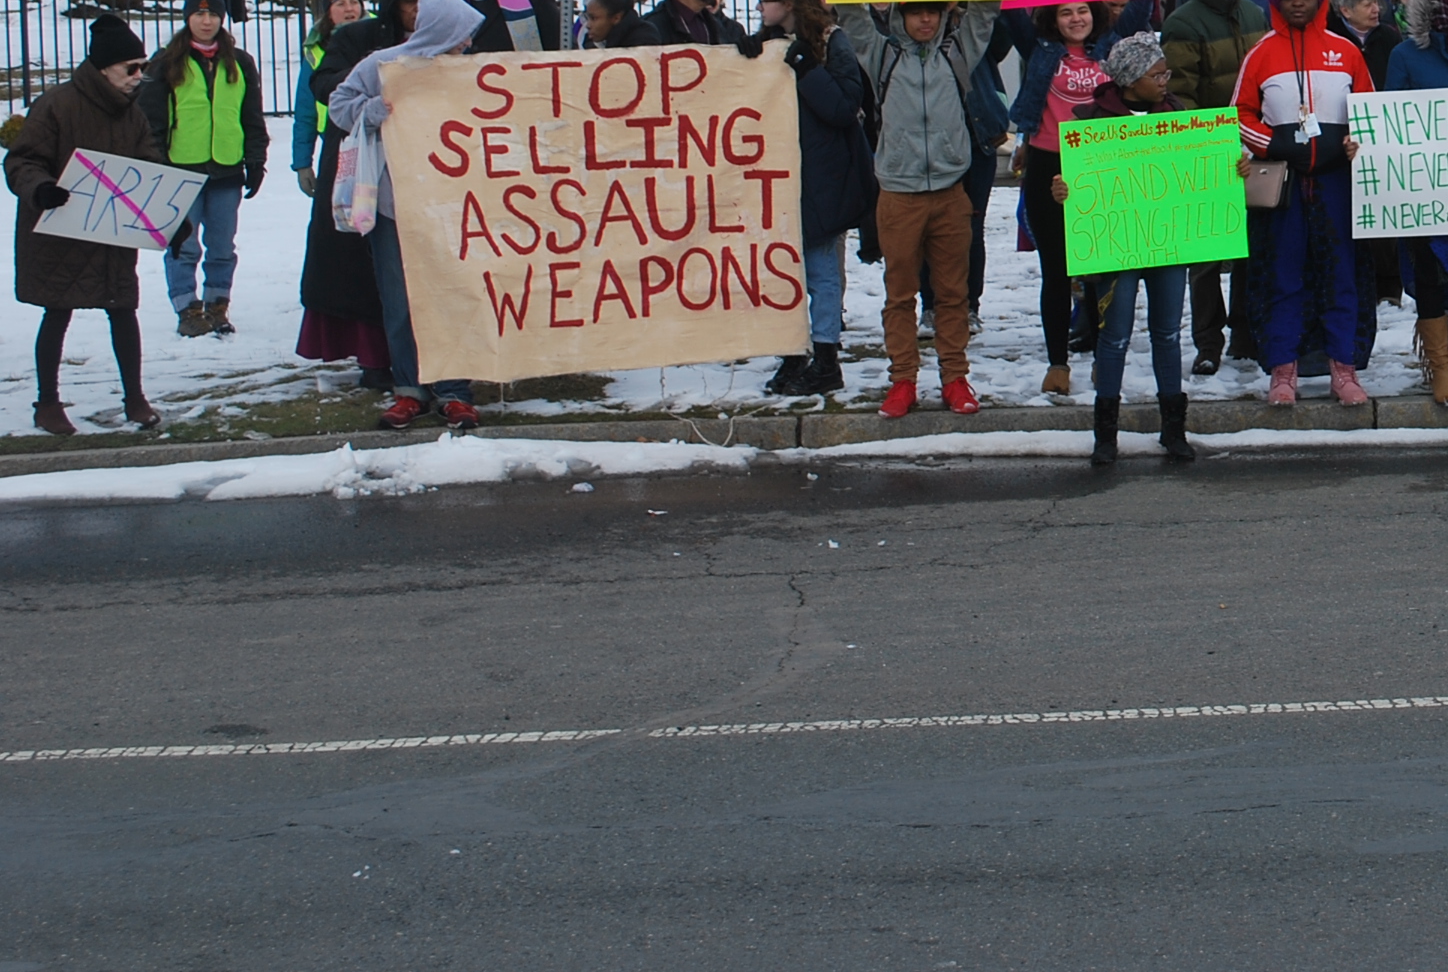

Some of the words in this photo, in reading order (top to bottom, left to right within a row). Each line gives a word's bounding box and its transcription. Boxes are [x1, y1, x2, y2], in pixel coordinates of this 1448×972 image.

[470, 48, 708, 120] STOP
[427, 107, 765, 178] SELLING
[43, 159, 203, 236] AR15
[459, 170, 790, 261] ASSAULT
[1073, 162, 1169, 215] STAND
[1171, 150, 1240, 194] WITH
[1072, 202, 1241, 261] SPRINGFIELD
[1116, 246, 1179, 269] YOUTH
[483, 242, 803, 337] WEAPONS
